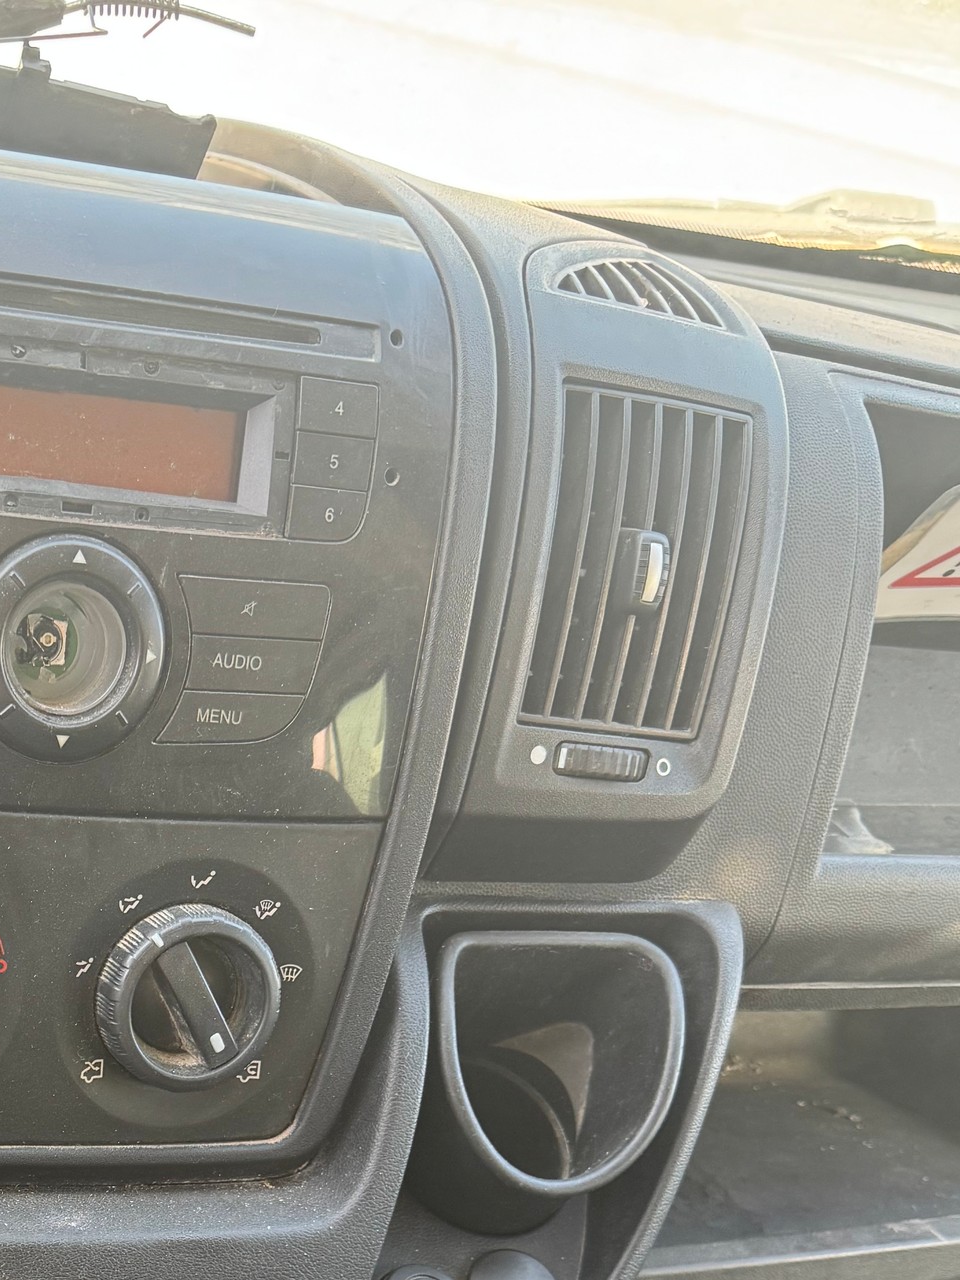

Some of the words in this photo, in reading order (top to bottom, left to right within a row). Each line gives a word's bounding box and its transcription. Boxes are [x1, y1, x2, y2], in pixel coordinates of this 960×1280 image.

[334, 400, 344, 416] 4
[329, 454, 339, 469] 5
[324, 507, 335, 523] 6
[212, 652, 263, 671] AUDIO
[196, 707, 243, 725] MENU
